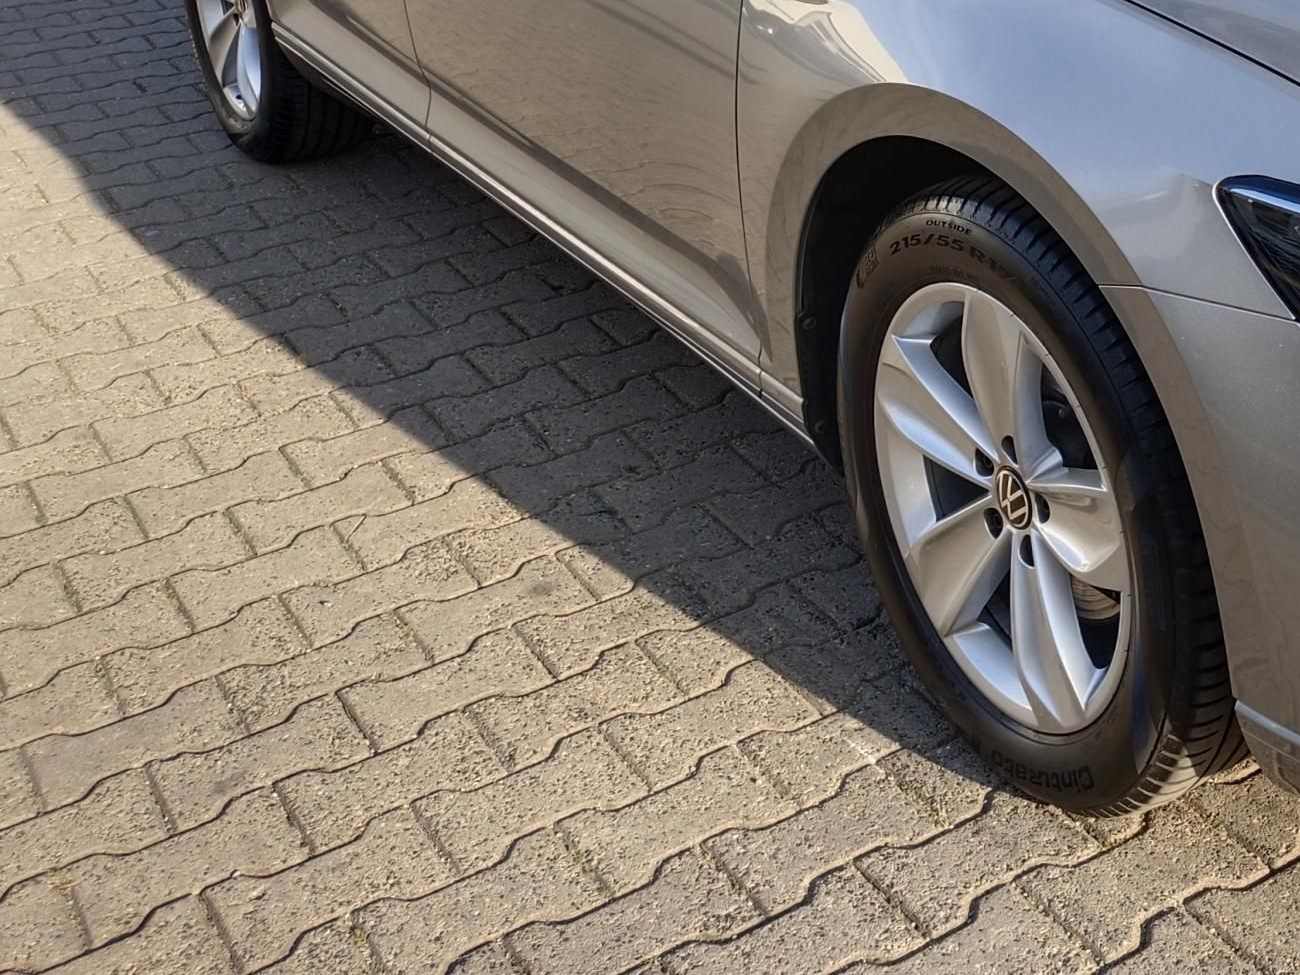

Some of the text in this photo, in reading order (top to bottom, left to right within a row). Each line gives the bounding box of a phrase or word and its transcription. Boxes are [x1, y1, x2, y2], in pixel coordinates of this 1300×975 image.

[925, 219, 973, 237] OUTSIDE
[889, 233, 965, 257] 215/55
[991, 749, 1096, 793] Cinturato
